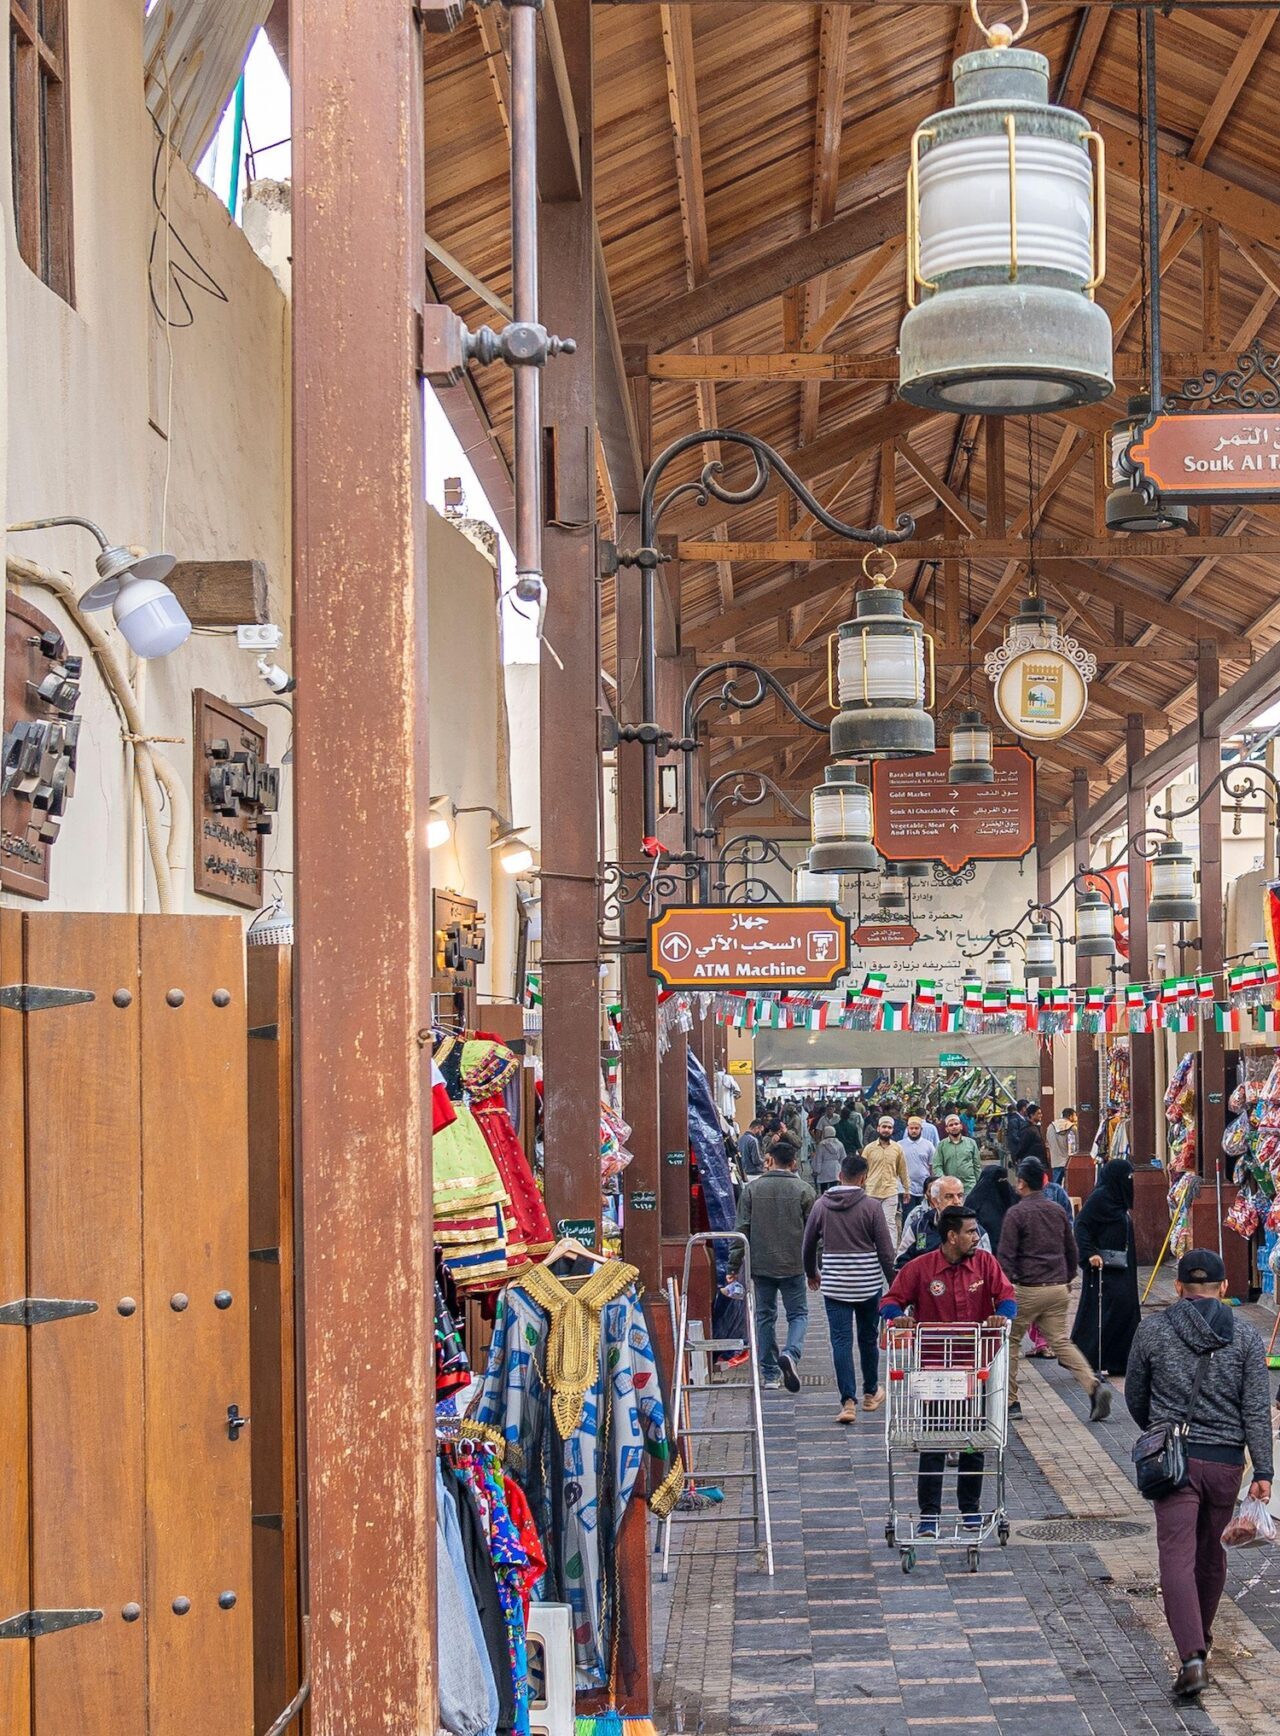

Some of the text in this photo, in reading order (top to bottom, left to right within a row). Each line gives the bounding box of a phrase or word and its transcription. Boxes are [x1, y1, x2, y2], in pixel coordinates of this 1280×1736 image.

[1213, 426, 1268, 452] التمر
[1183, 454, 1234, 472] Souk
[1241, 455, 1263, 471] Al
[1001, 789, 1018, 797] سوق
[729, 913, 769, 931] جهاز
[928, 911, 963, 922] بحضرة
[695, 934, 802, 958] السحب الآلي
[694, 962, 807, 977] ATM Machine
[869, 961, 890, 971] سوق
